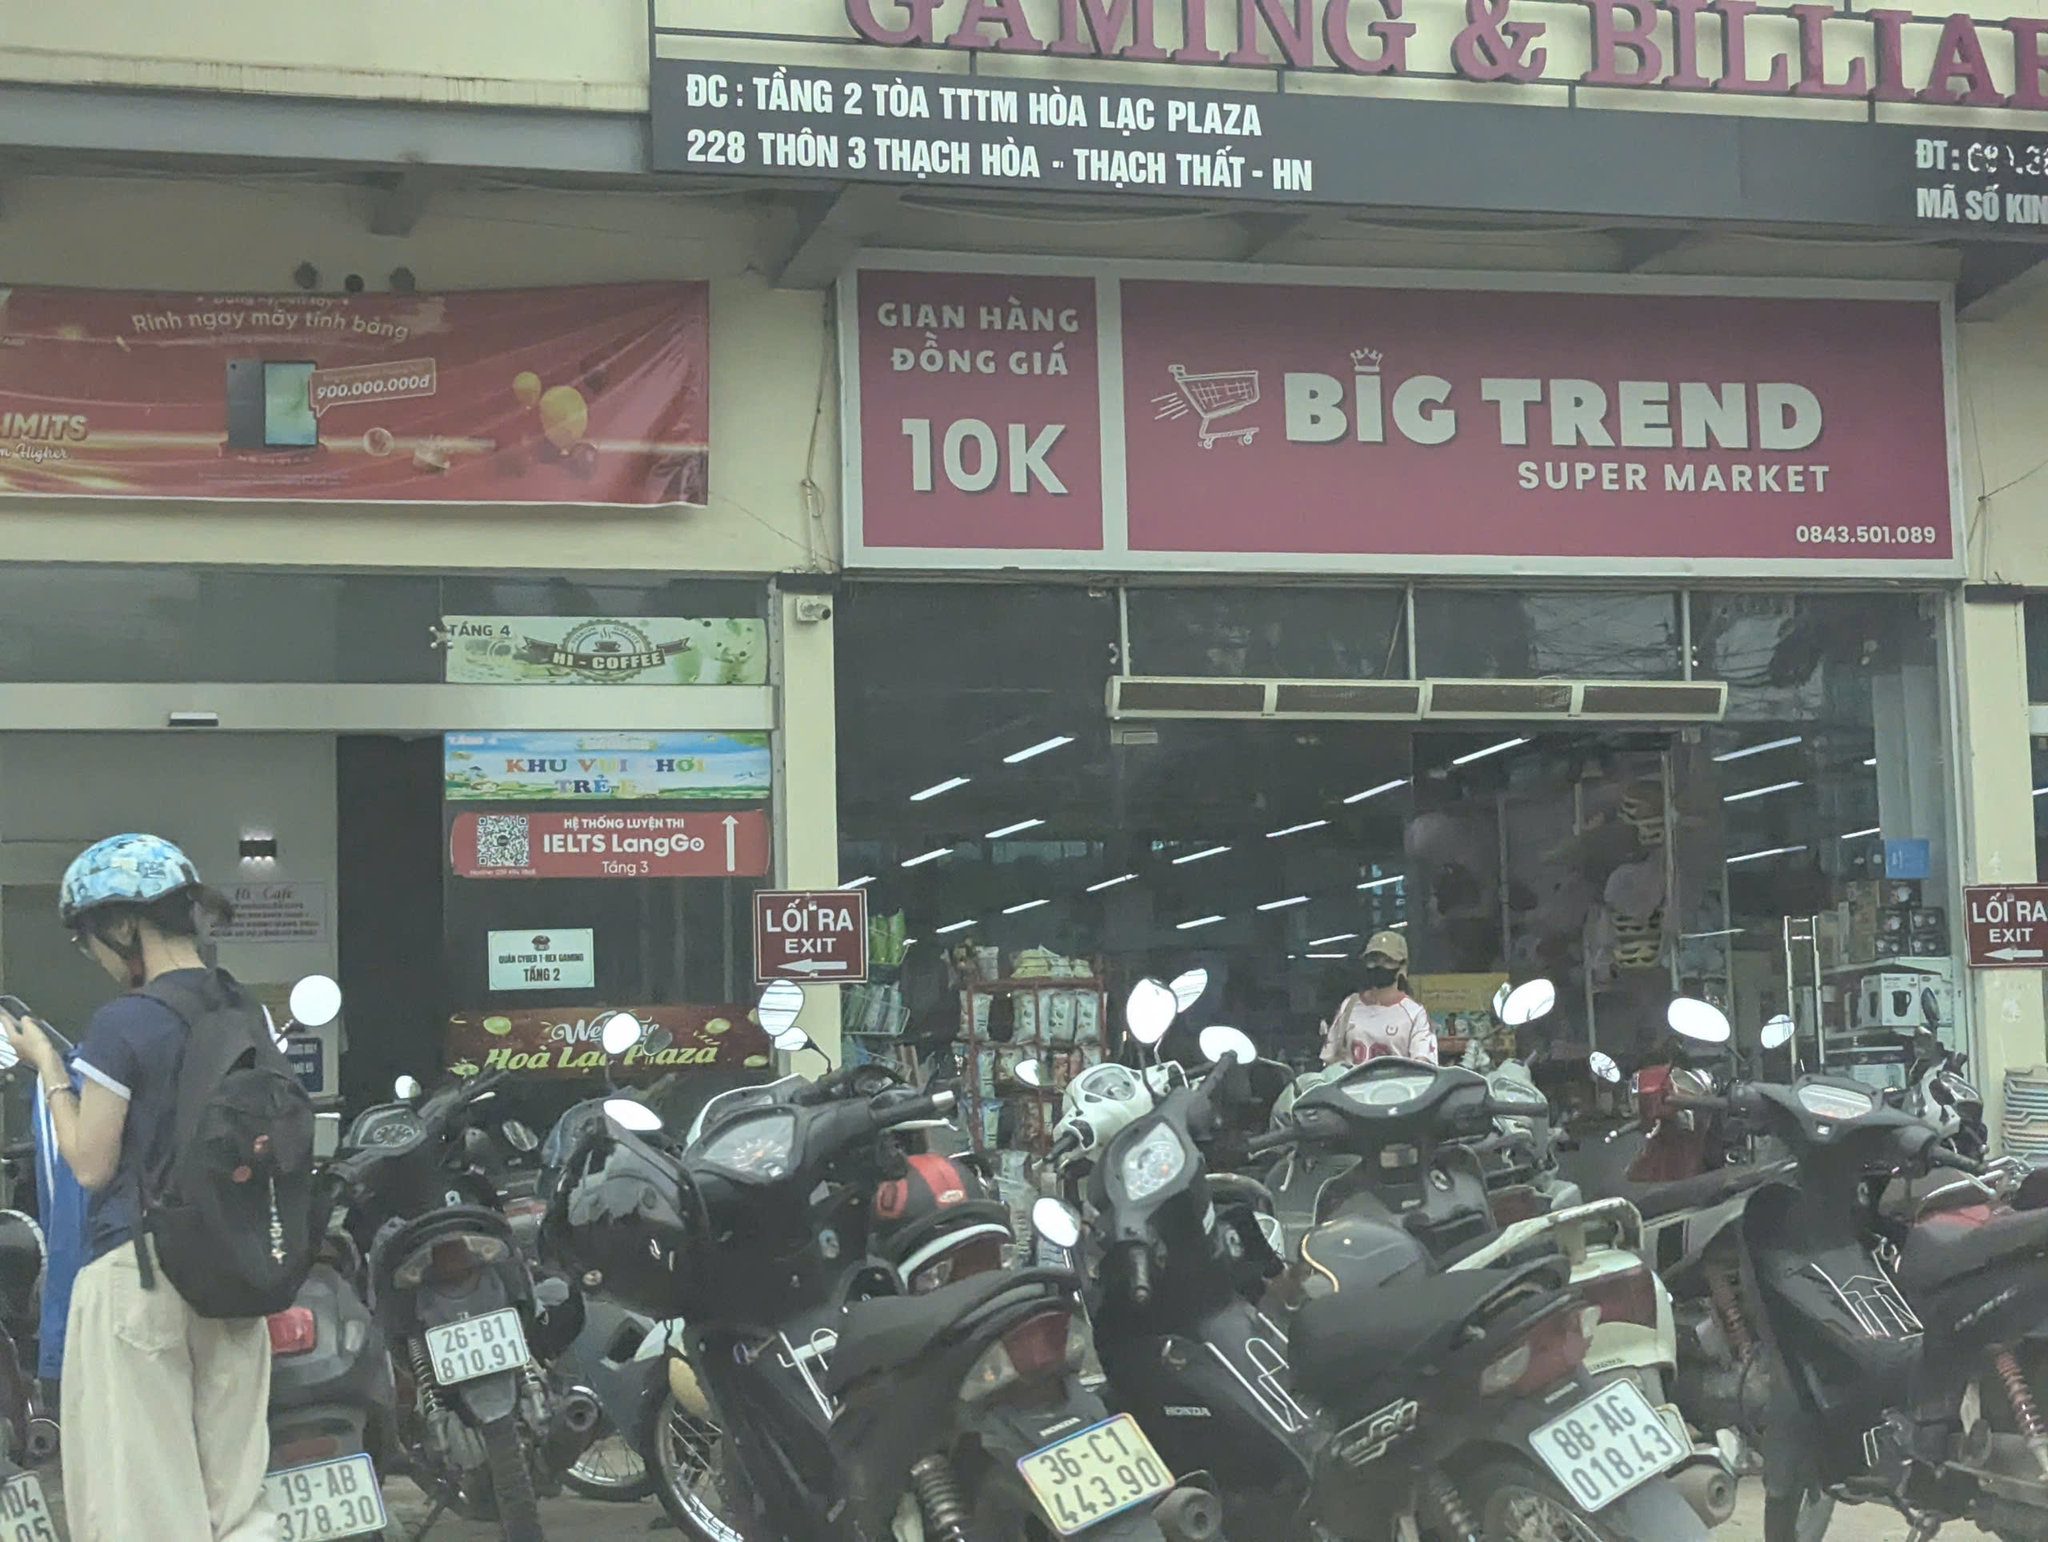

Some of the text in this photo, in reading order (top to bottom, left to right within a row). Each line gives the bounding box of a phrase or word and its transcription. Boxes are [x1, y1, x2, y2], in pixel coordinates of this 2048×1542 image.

[846, 0, 1416, 75] GAMING
[1450, 0, 1547, 84] &
[753, 66, 833, 113] TẦNG
[843, 82, 864, 116] 2
[872, 78, 929, 119] TÒA
[939, 86, 1019, 123] TTTM
[1028, 85, 1088, 128] HÒA
[1099, 97, 1155, 137] LẠC
[1167, 100, 1262, 137] PLAZA
[686, 129, 744, 163] 228
[758, 127, 838, 168] THÔN
[848, 136, 866, 169] 3
[874, 137, 971, 179] THẠCH
[981, 136, 1039, 178] HÒA
[1073, 148, 1166, 190] THẠCH
[1177, 145, 1246, 188] THẤT
[1272, 158, 1312, 191] HN
[1916, 184, 1960, 219] MÃ
[1965, 184, 2000, 222] SỐ
[132, 309, 408, 342] Rinh ngay máy tính bảng
[878, 297, 1079, 333] GIAN HÀNG
[891, 332, 1069, 376] ĐỒNG GIÁ
[1284, 370, 1822, 451] BIG TREND
[902, 418, 1068, 494] 10K
[1518, 461, 1830, 493] SUPER MARKET
[1796, 525, 1936, 545] 0843.501.089
[500, 625, 511, 636] 4
[553, 652, 573, 666] HI
[592, 652, 662, 669] COFFEE
[506, 759, 567, 772] KHU
[578, 759, 628, 772] VUI
[555, 775, 610, 794] TRẺ
[564, 816, 684, 831] HỆ THỐNG LUYỆN THI
[544, 834, 705, 857] IELTS LangGo
[640, 861, 649, 873] 3
[766, 899, 854, 934] LỐI RA
[1972, 891, 2048, 923] LỐI RA
[785, 937, 837, 954] EXIT
[1989, 927, 2034, 943] EXIT
[553, 967, 560, 981] 2
[624, 1045, 718, 1066] Paza
[442, 1320, 508, 1354] 26-B1
[441, 1343, 523, 1381] 810.91
[1164, 1406, 1211, 1417] HONDA
[1552, 1395, 1636, 1460] 88-AG
[1040, 1427, 1130, 1485] 36-C1
[1571, 1424, 1673, 1500] 018.43
[280, 1464, 358, 1506] 19-AB
[1054, 1457, 1161, 1524] 443.90
[278, 1496, 377, 1542] 378.30
